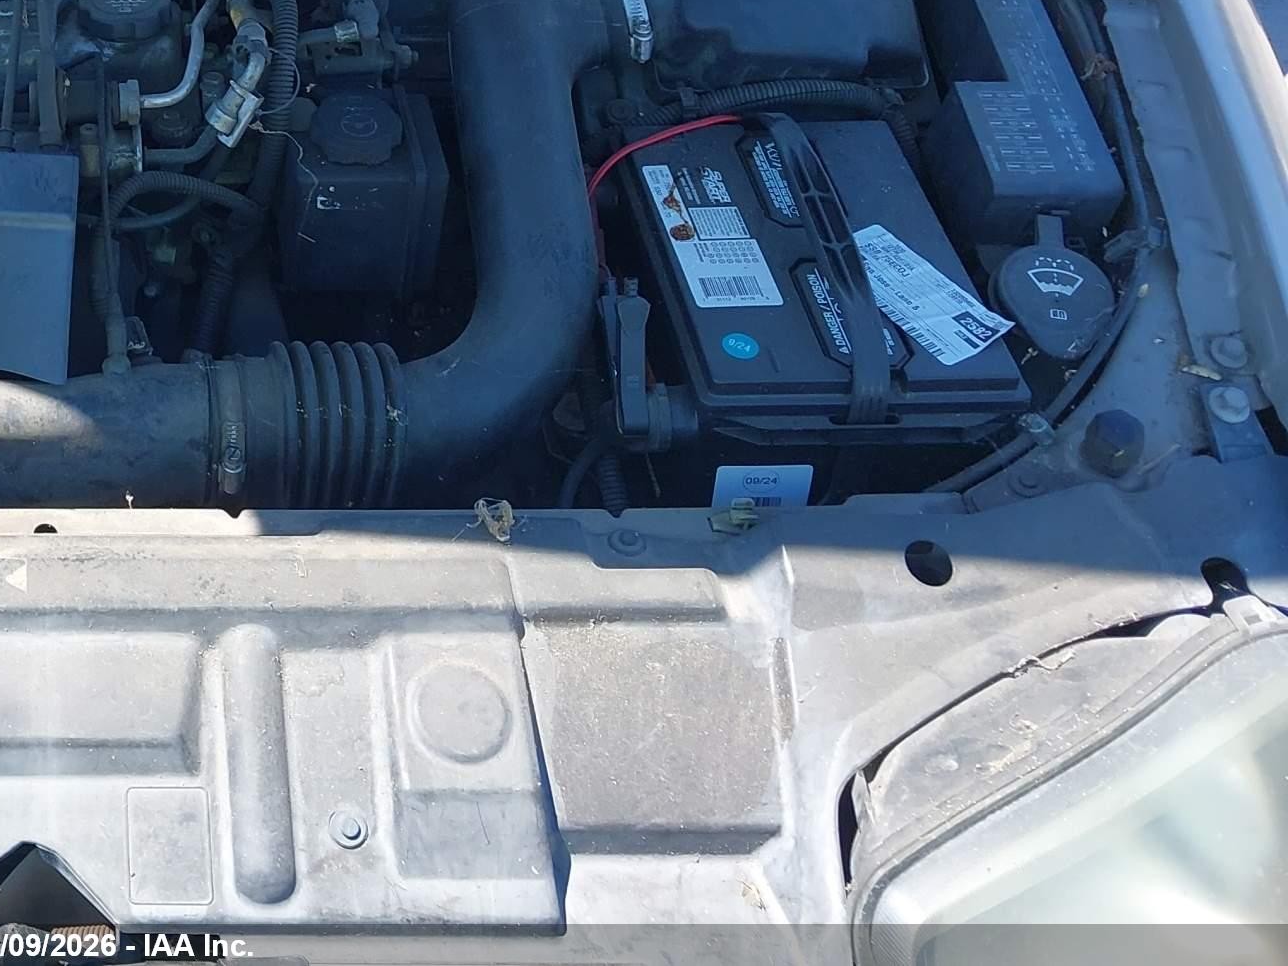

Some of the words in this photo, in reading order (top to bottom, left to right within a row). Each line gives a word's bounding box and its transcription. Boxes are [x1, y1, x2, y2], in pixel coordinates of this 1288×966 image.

[806, 273, 828, 305] POISON
[822, 311, 846, 346] DANGER
[959, 317, 993, 341] 2582
[745, 476, 778, 486] 09/24
